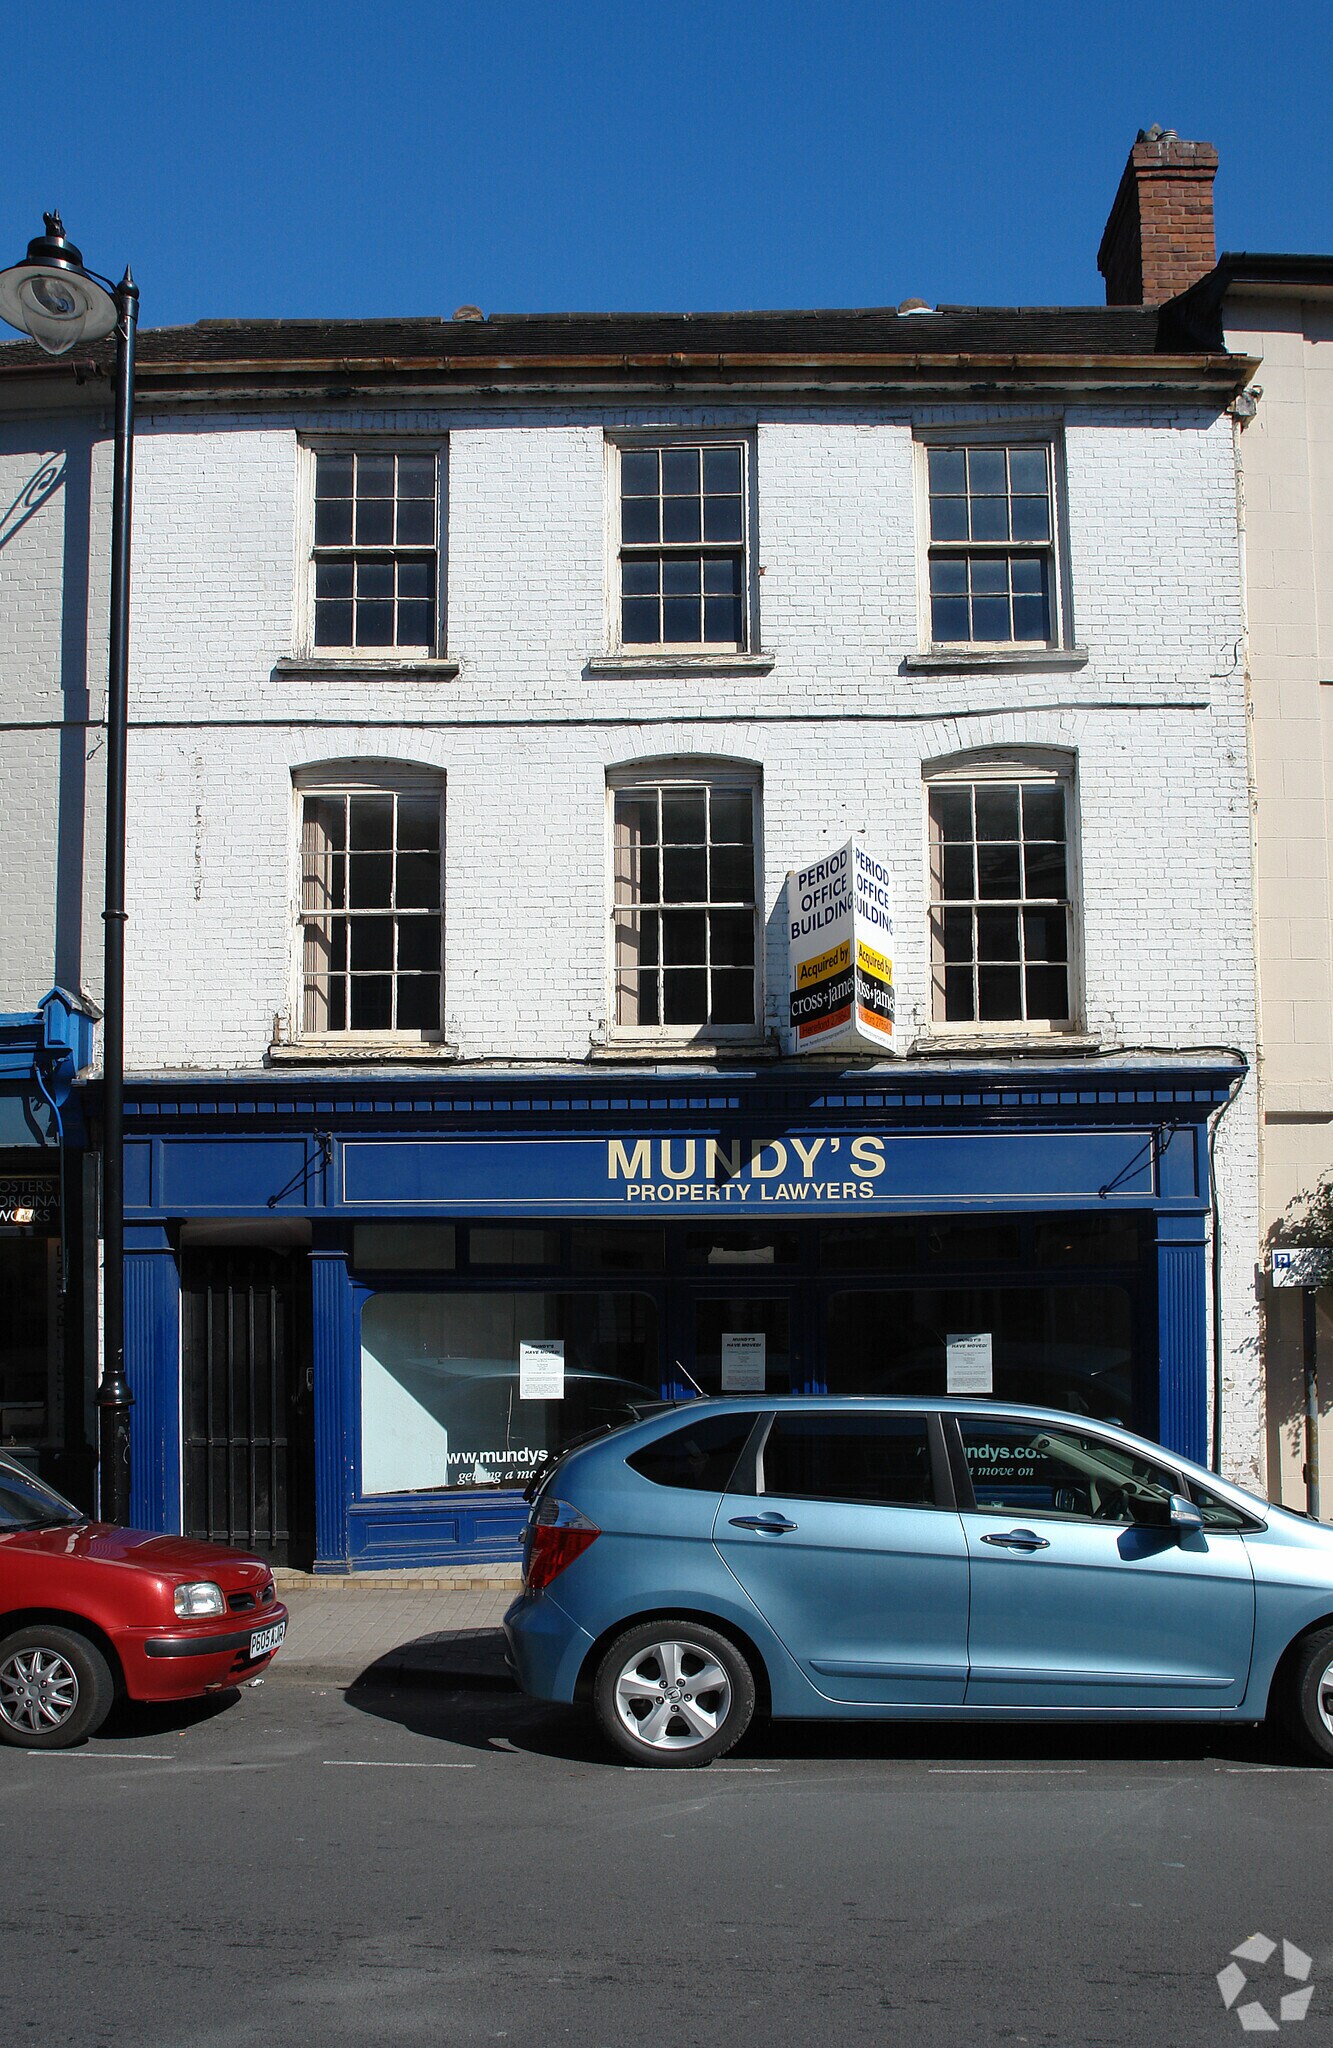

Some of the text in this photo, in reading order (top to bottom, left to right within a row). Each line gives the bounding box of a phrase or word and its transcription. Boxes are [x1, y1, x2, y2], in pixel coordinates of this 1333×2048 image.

[799, 850, 848, 891] PERIOD
[856, 847, 889, 886] PERIOD
[801, 873, 847, 912] OFFICE
[857, 873, 889, 910] OFFICE
[854, 892, 894, 936] UILDING
[800, 946, 849, 980] Acquired by
[858, 944, 892, 981] Acquired by
[607, 1136, 886, 1180] MUNDY'S
[626, 1181, 875, 1202] PROPERTY LAWYERS
[505, 1470, 513, 1480] a
[977, 1467, 1014, 1476] move
[1018, 1467, 1034, 1476] on
